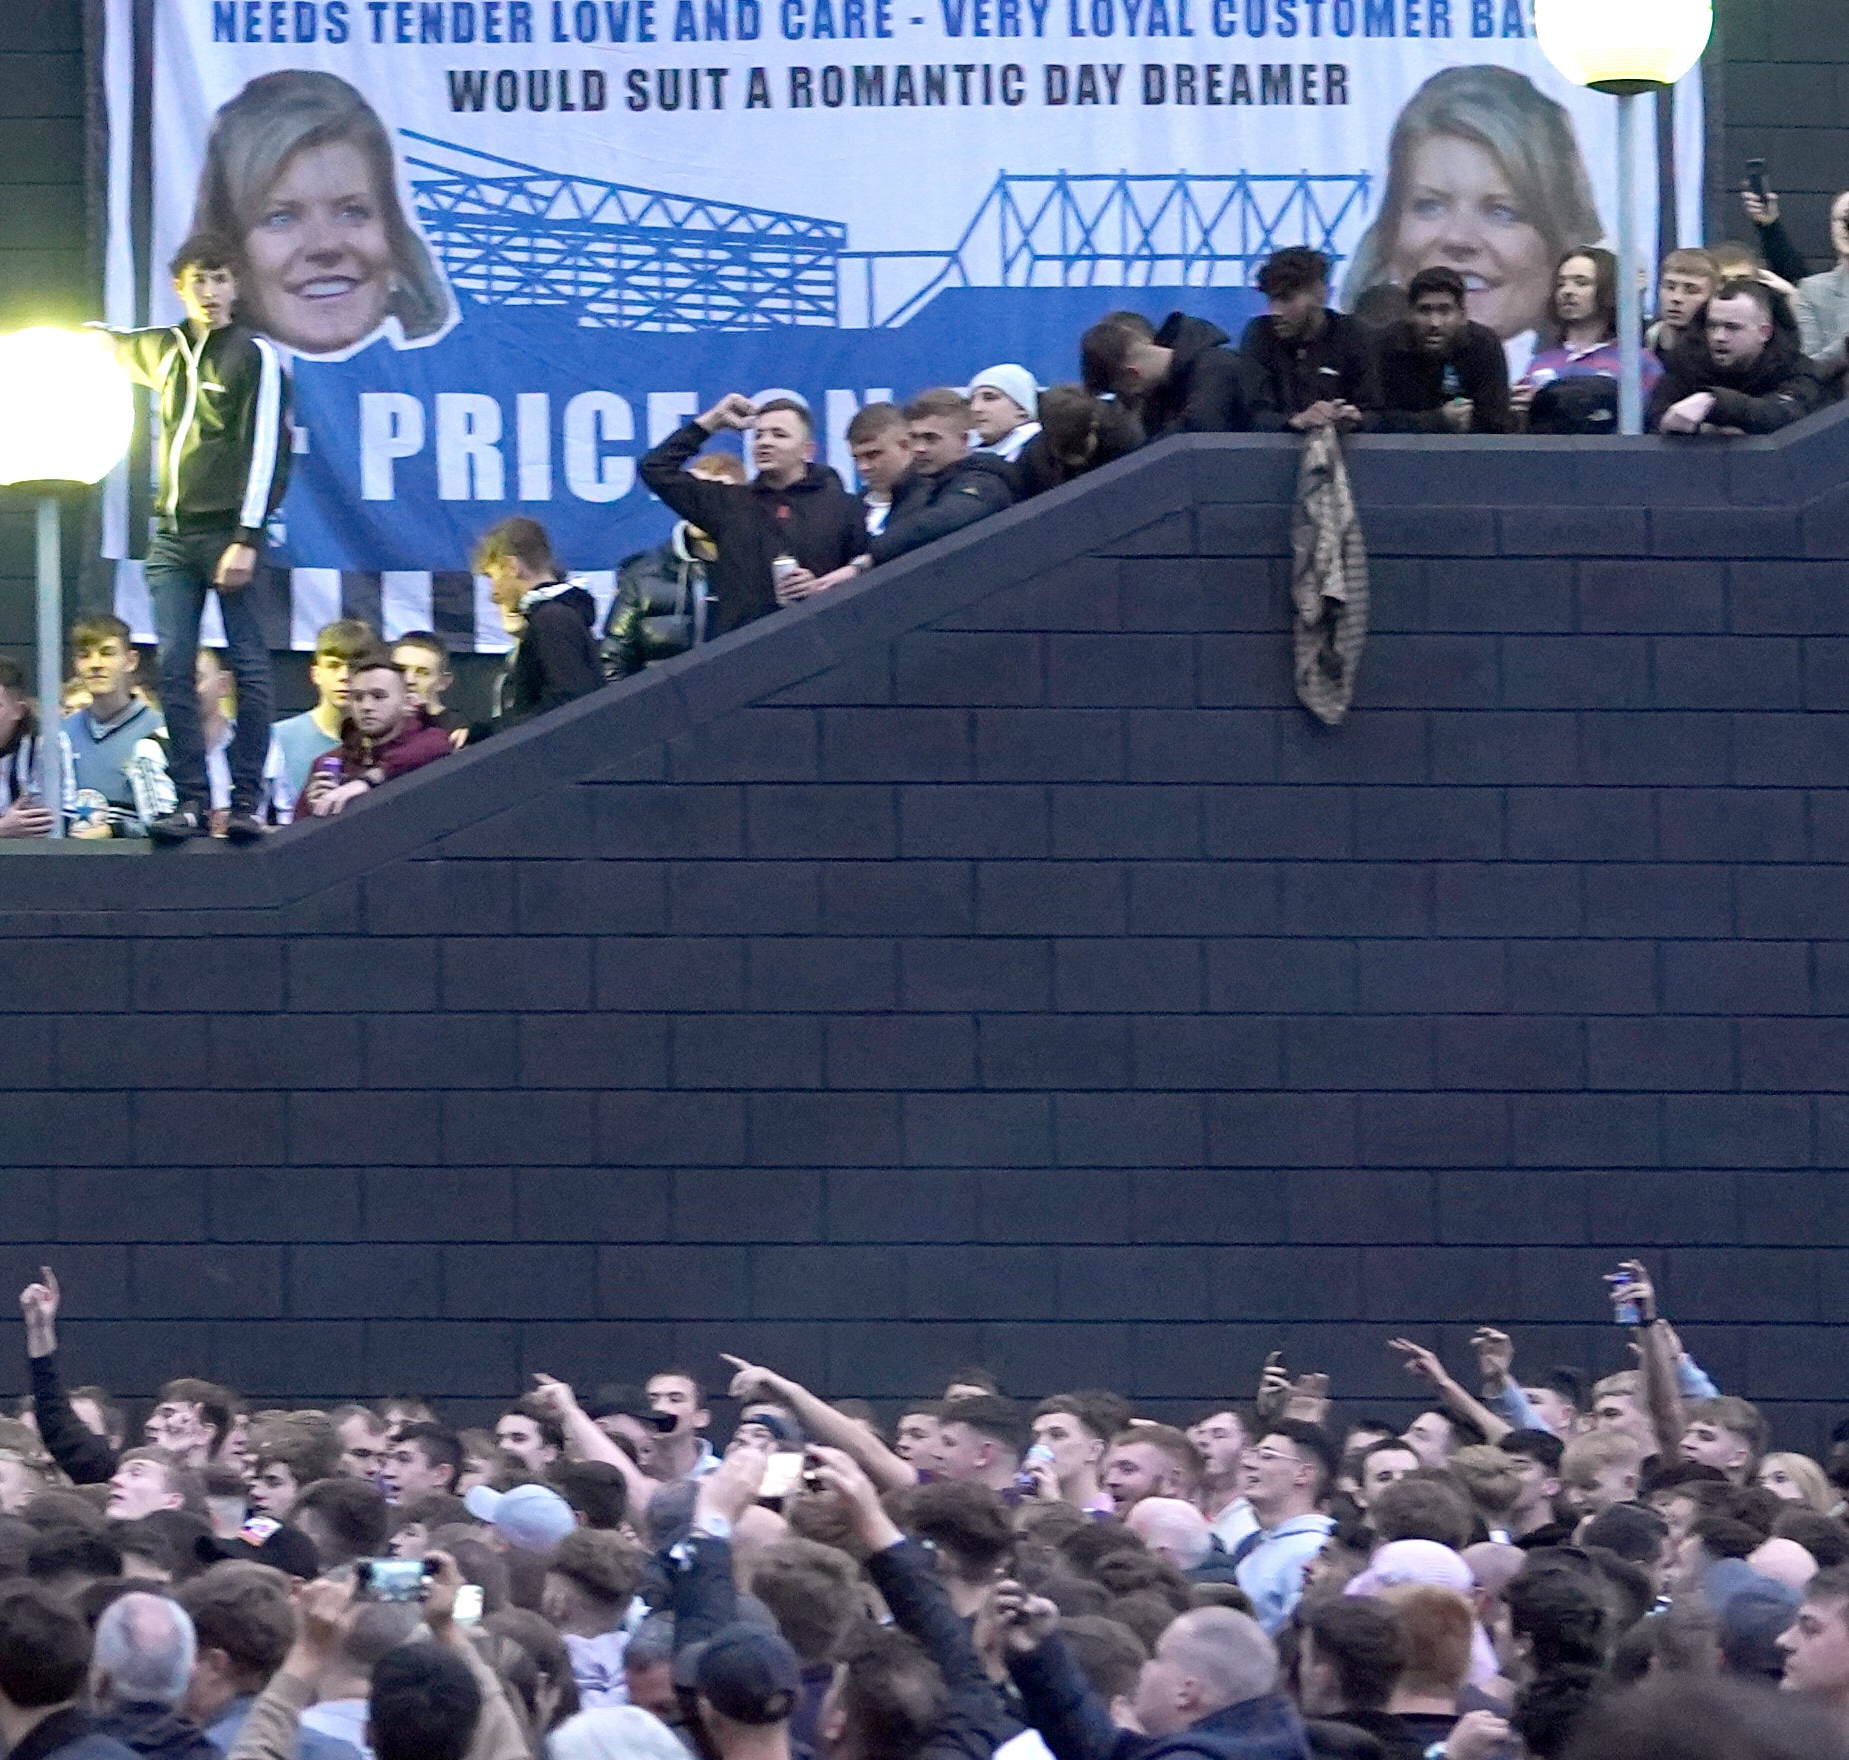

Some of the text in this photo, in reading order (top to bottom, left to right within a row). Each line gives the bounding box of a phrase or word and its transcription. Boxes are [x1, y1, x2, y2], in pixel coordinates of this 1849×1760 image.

[211, 0, 350, 44] NEEDS
[366, 0, 533, 43] TENDER
[446, 64, 1351, 113] WOULD SUIT A ROMANTIC DAY DREAMER
